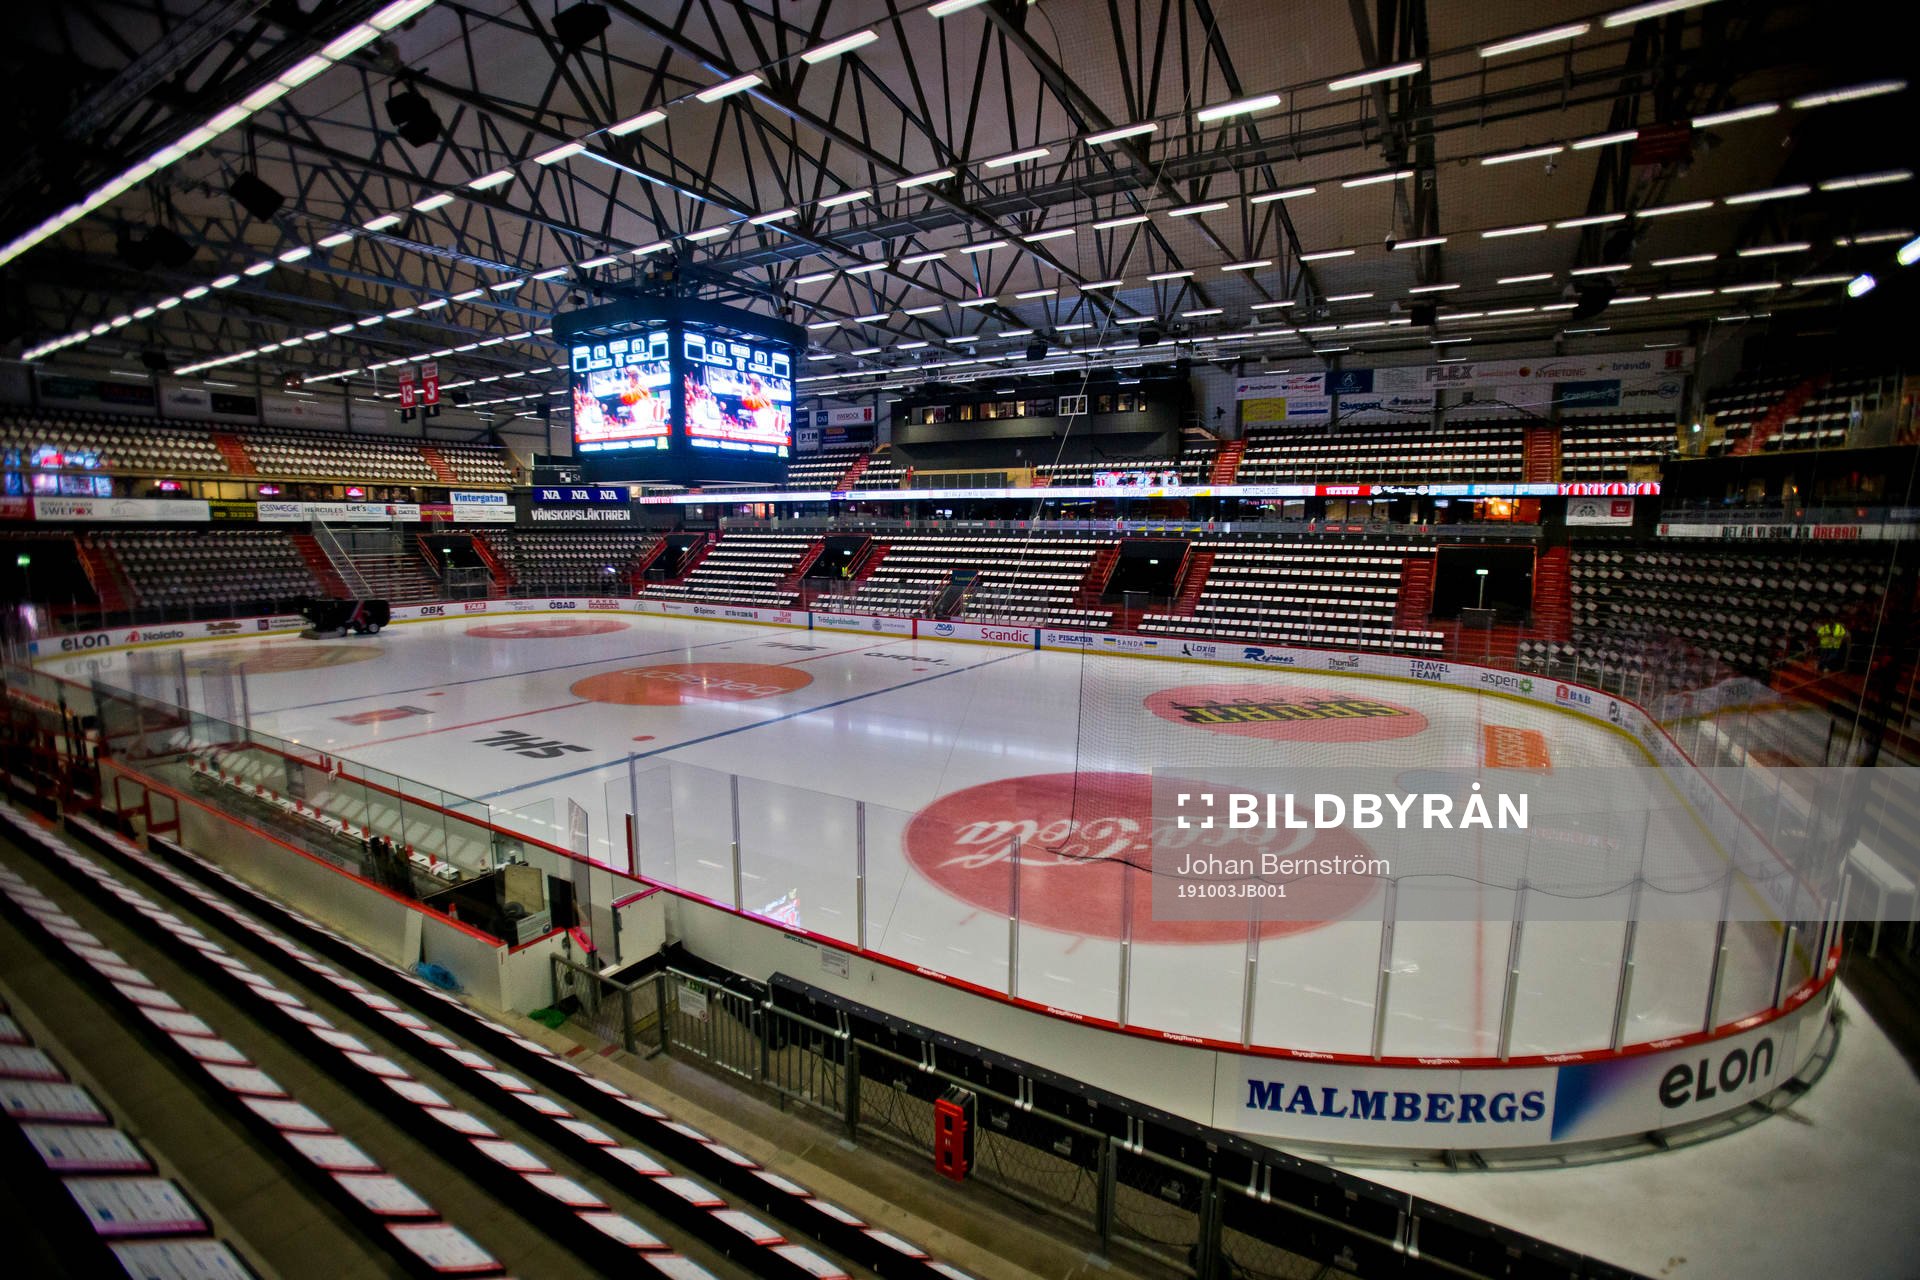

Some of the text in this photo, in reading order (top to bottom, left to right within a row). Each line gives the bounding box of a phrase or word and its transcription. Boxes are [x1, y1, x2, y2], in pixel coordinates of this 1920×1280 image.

[402, 384, 413, 404] 13
[427, 381, 434, 400] 3
[454, 493, 503, 503] Vintergatan
[543, 490, 561, 500] NA
[571, 490, 589, 500] NA
[600, 490, 618, 500] NA
[531, 508, 630, 521] VÄNSKAPSLÄKTAREN
[981, 627, 1030, 643] Scandic
[1117, 639, 1144, 647] SANDA
[1409, 659, 1450, 673] TRAVEL
[1410, 667, 1441, 681] TEAM
[1480, 671, 1519, 688] aspen
[1246, 1079, 1546, 1123] MALMBERGS
